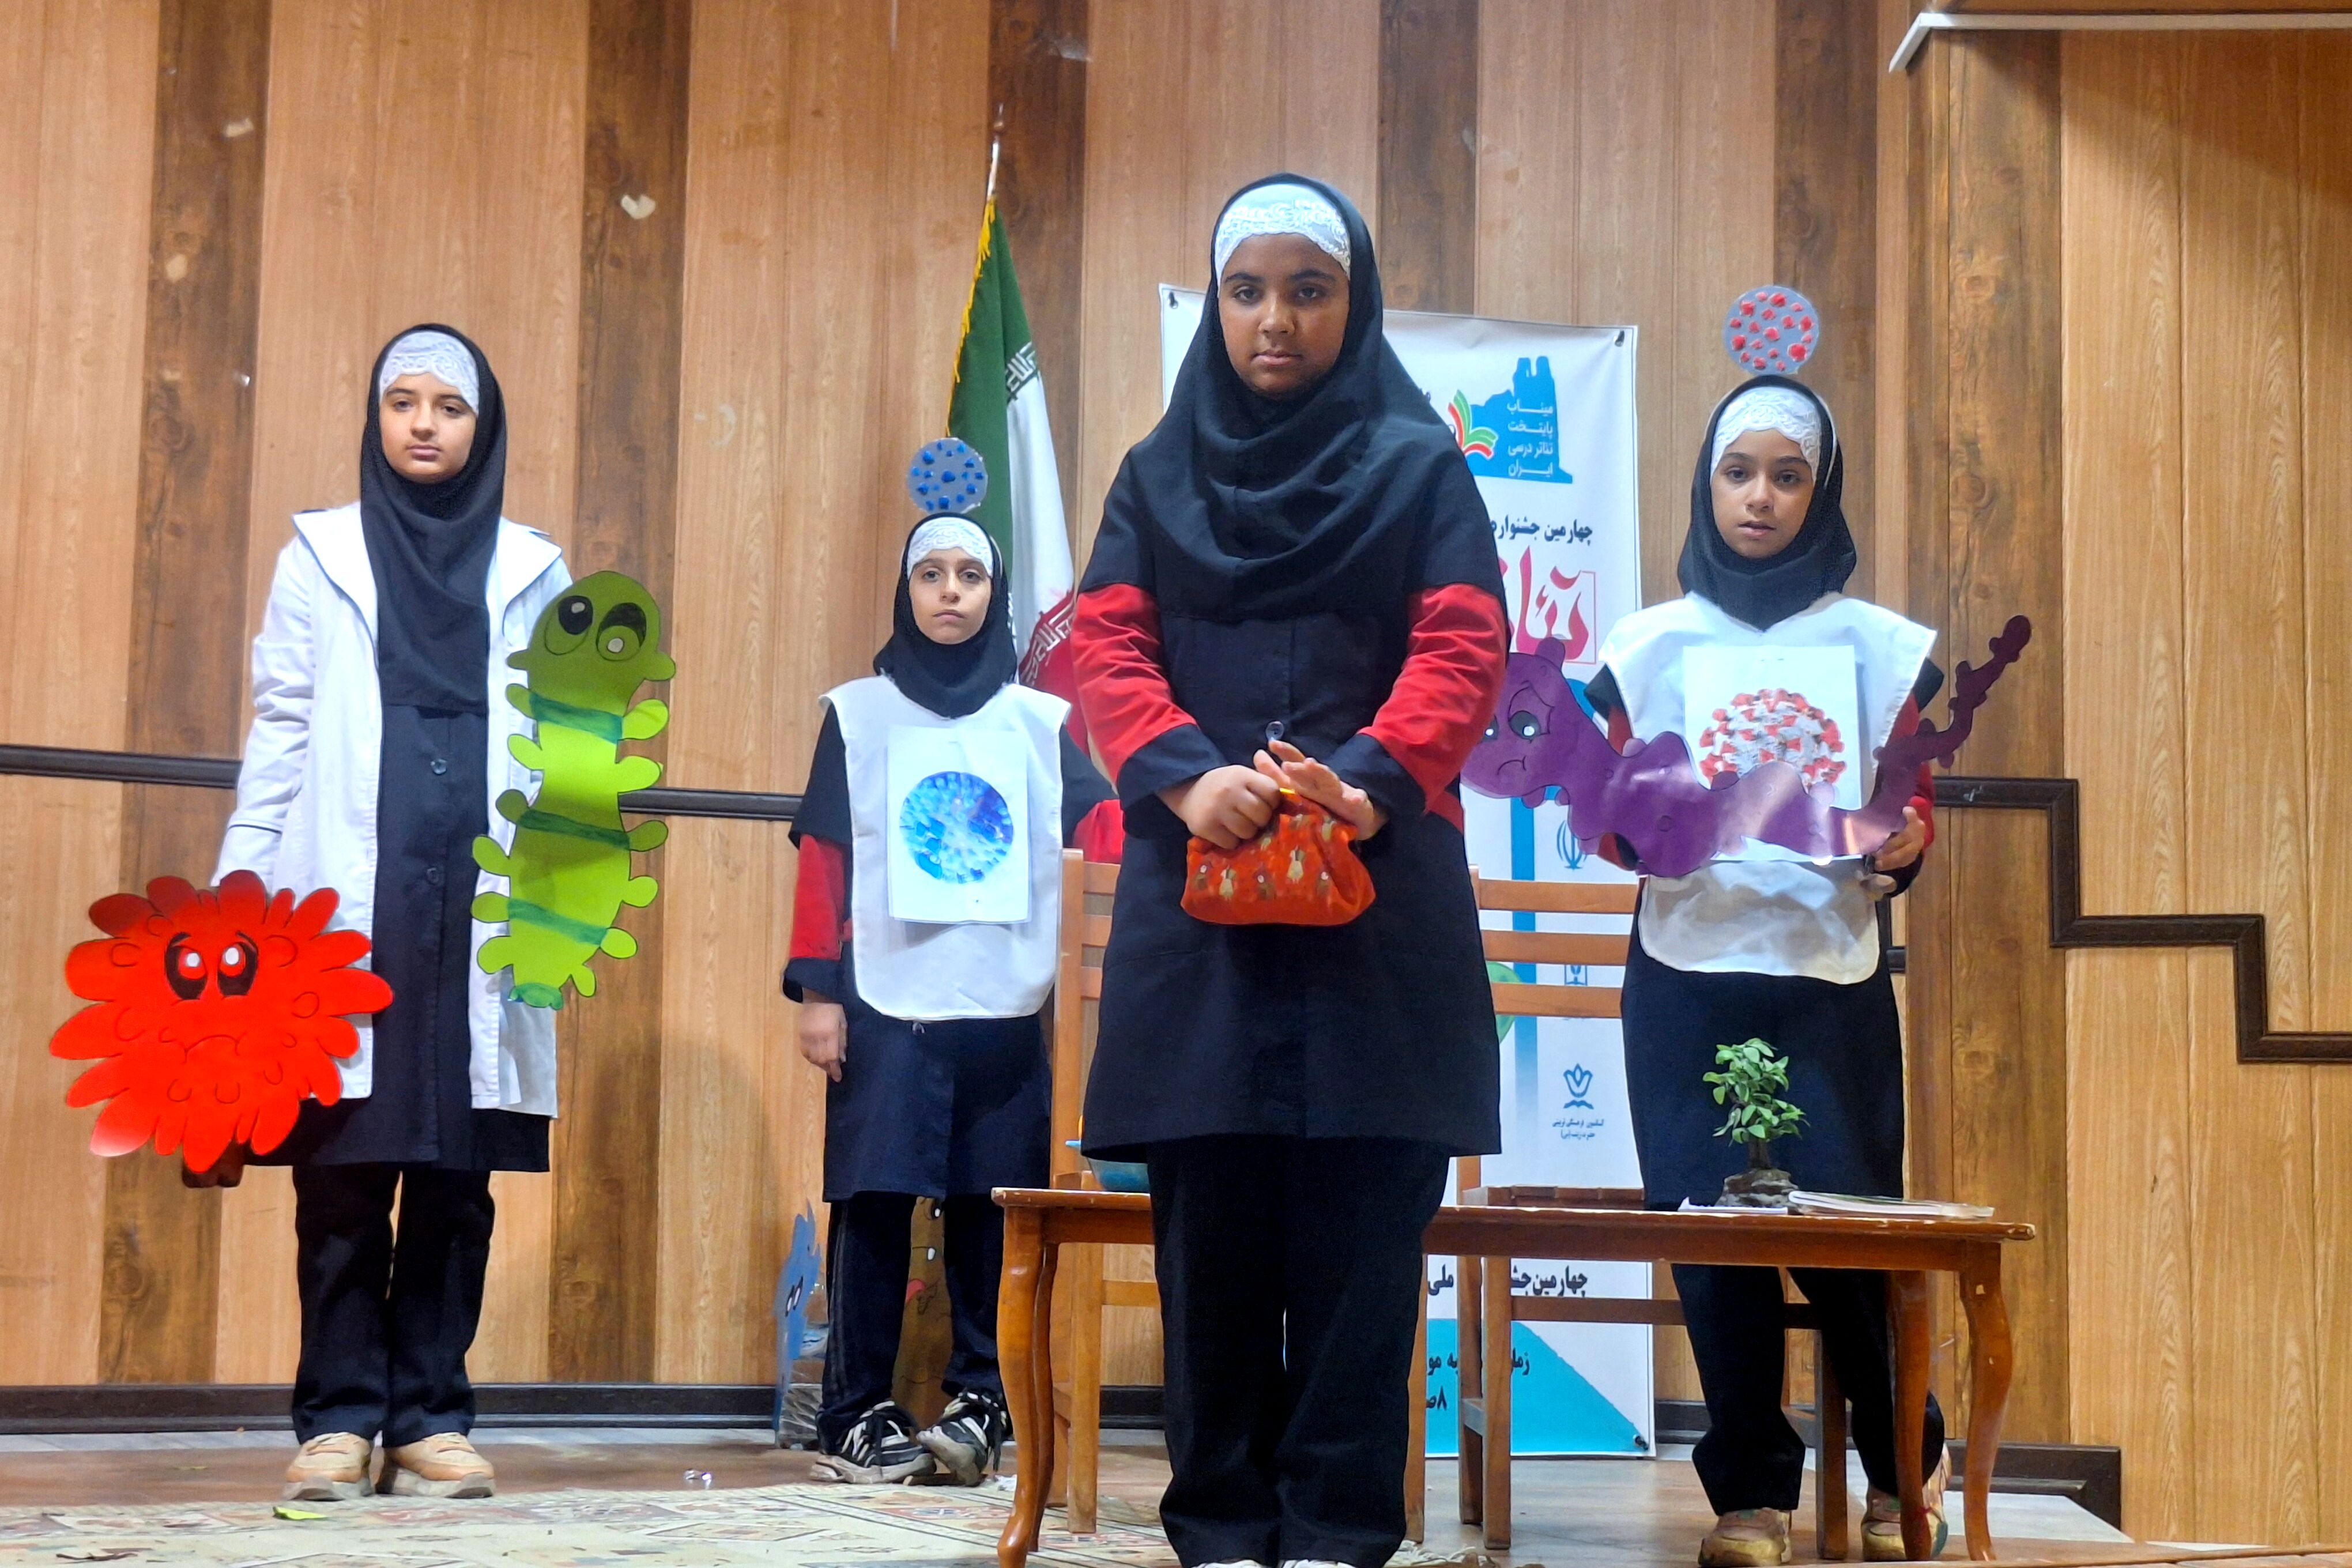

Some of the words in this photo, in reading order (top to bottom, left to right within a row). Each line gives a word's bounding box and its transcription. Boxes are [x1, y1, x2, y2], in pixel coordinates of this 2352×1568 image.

[1507, 420, 1553, 439] پایتخت
[1508, 443, 1532, 458] درسی
[1508, 459, 1553, 477] ایران
[1491, 514, 1540, 540] جشنواره
[1544, 519, 1592, 546] چهارمین
[1428, 1264, 1454, 1296] ملی
[1533, 1265, 1588, 1296] چهارمین
[1512, 1347, 1529, 1375] زما
